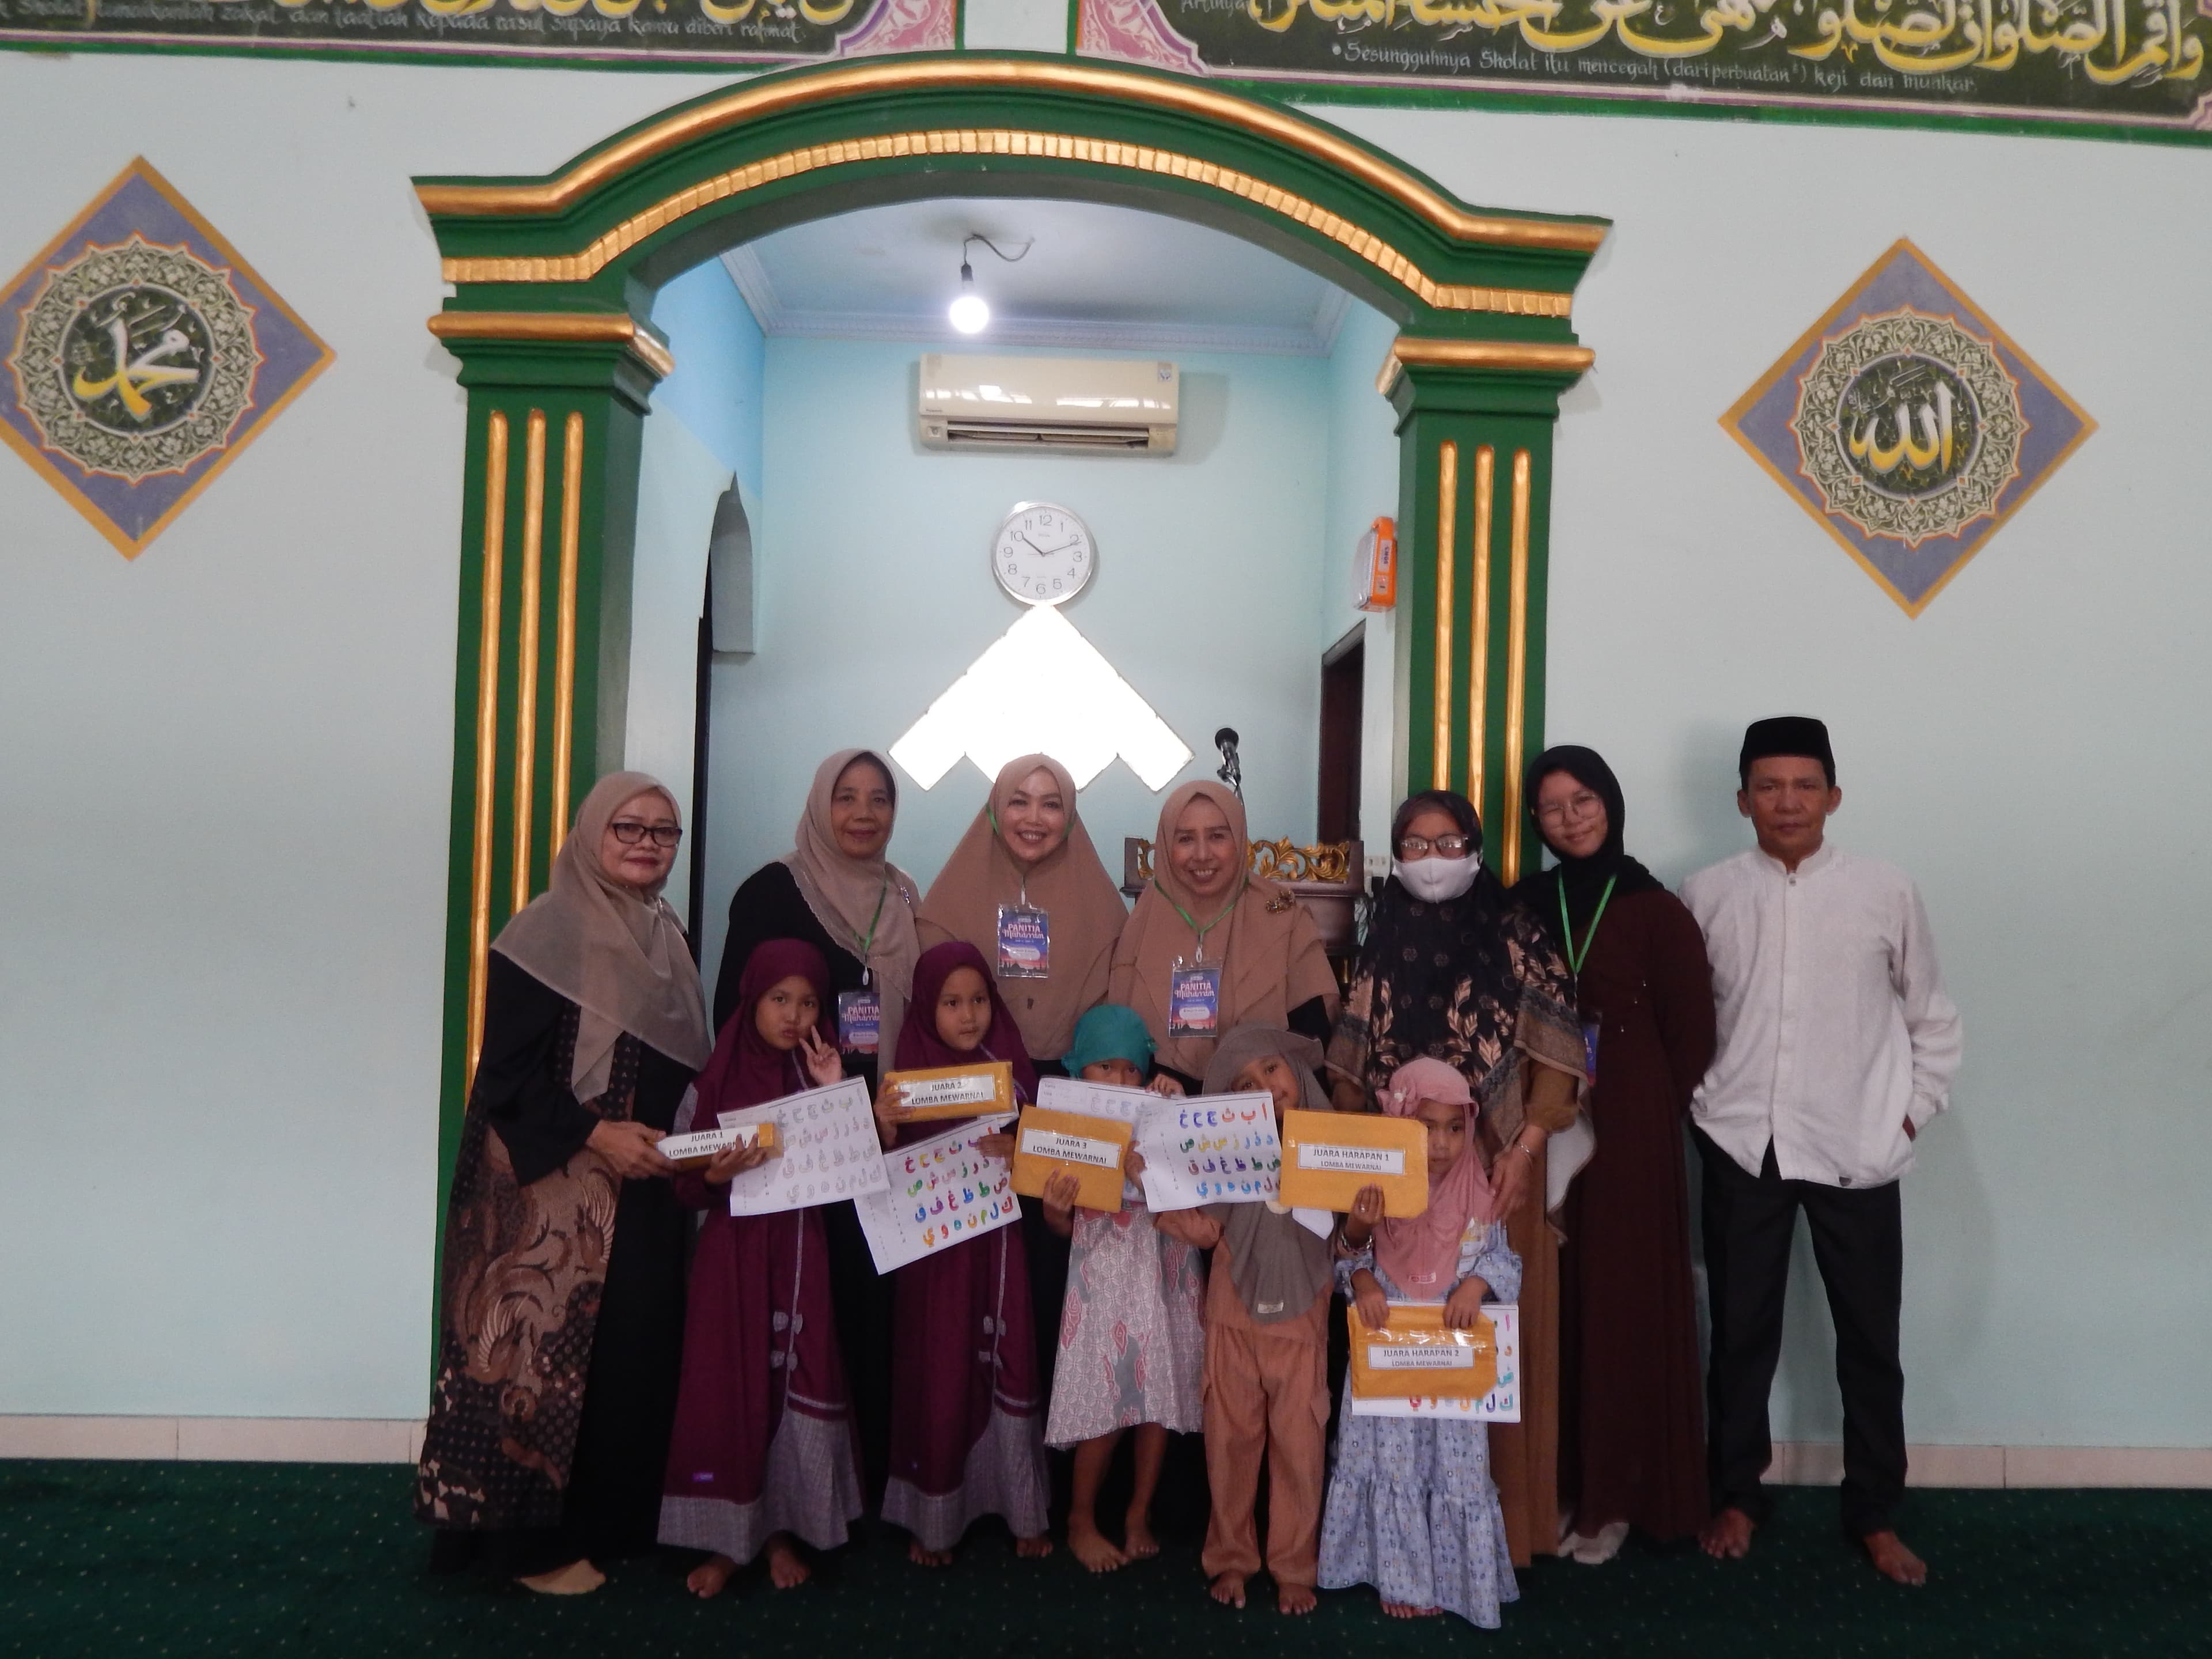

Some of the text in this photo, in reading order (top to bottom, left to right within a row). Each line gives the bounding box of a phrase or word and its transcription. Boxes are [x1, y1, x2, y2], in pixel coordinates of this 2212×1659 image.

[1344, 41, 1471, 74] Sesungguhnya
[1479, 37, 1537, 70] Sholat
[1545, 52, 1570, 74] itu
[1578, 58, 1659, 81] mencegah
[1815, 63, 1848, 92] keji
[1860, 73, 1893, 89] dan
[1025, 520, 1032, 531] 11
[1039, 514, 1052, 526] 12
[1060, 522, 1064, 532] 1
[1010, 531, 1024, 542] 10
[1070, 534, 1080, 545] 2
[1003, 547, 1014, 558] 9
[1073, 551, 1083, 562] 3
[1008, 564, 1017, 575] 8
[1067, 567, 1075, 578] 4
[1022, 577, 1031, 588] 7
[1053, 578, 1062, 589] 5
[1036, 584, 1046, 594] 6
[1008, 923, 1040, 933] PANITIA
[1002, 929, 1044, 939] Muharram
[1180, 982, 1211, 991] PANITIA
[1174, 989, 1215, 999] Muharram
[848, 1006, 880, 1014] PANITIA
[931, 1083, 955, 1091] JUARA
[912, 1092, 984, 1105] LOMBA MEWARNAI
[1241, 1111, 1256, 1124] ب
[1262, 1103, 1267, 1121] ا
[1180, 1109, 1188, 1129] خ
[1194, 1112, 1203, 1128] ح
[1207, 1111, 1218, 1127] ج
[691, 1133, 717, 1142] JUARA
[1056, 1138, 1080, 1147] JUARA
[669, 1147, 698, 1157] LOMBA
[1033, 1145, 1107, 1164] LOMBA MEWARNAI
[1313, 1149, 1340, 1157] JUARA
[1342, 1151, 1382, 1161] HARAPAN
